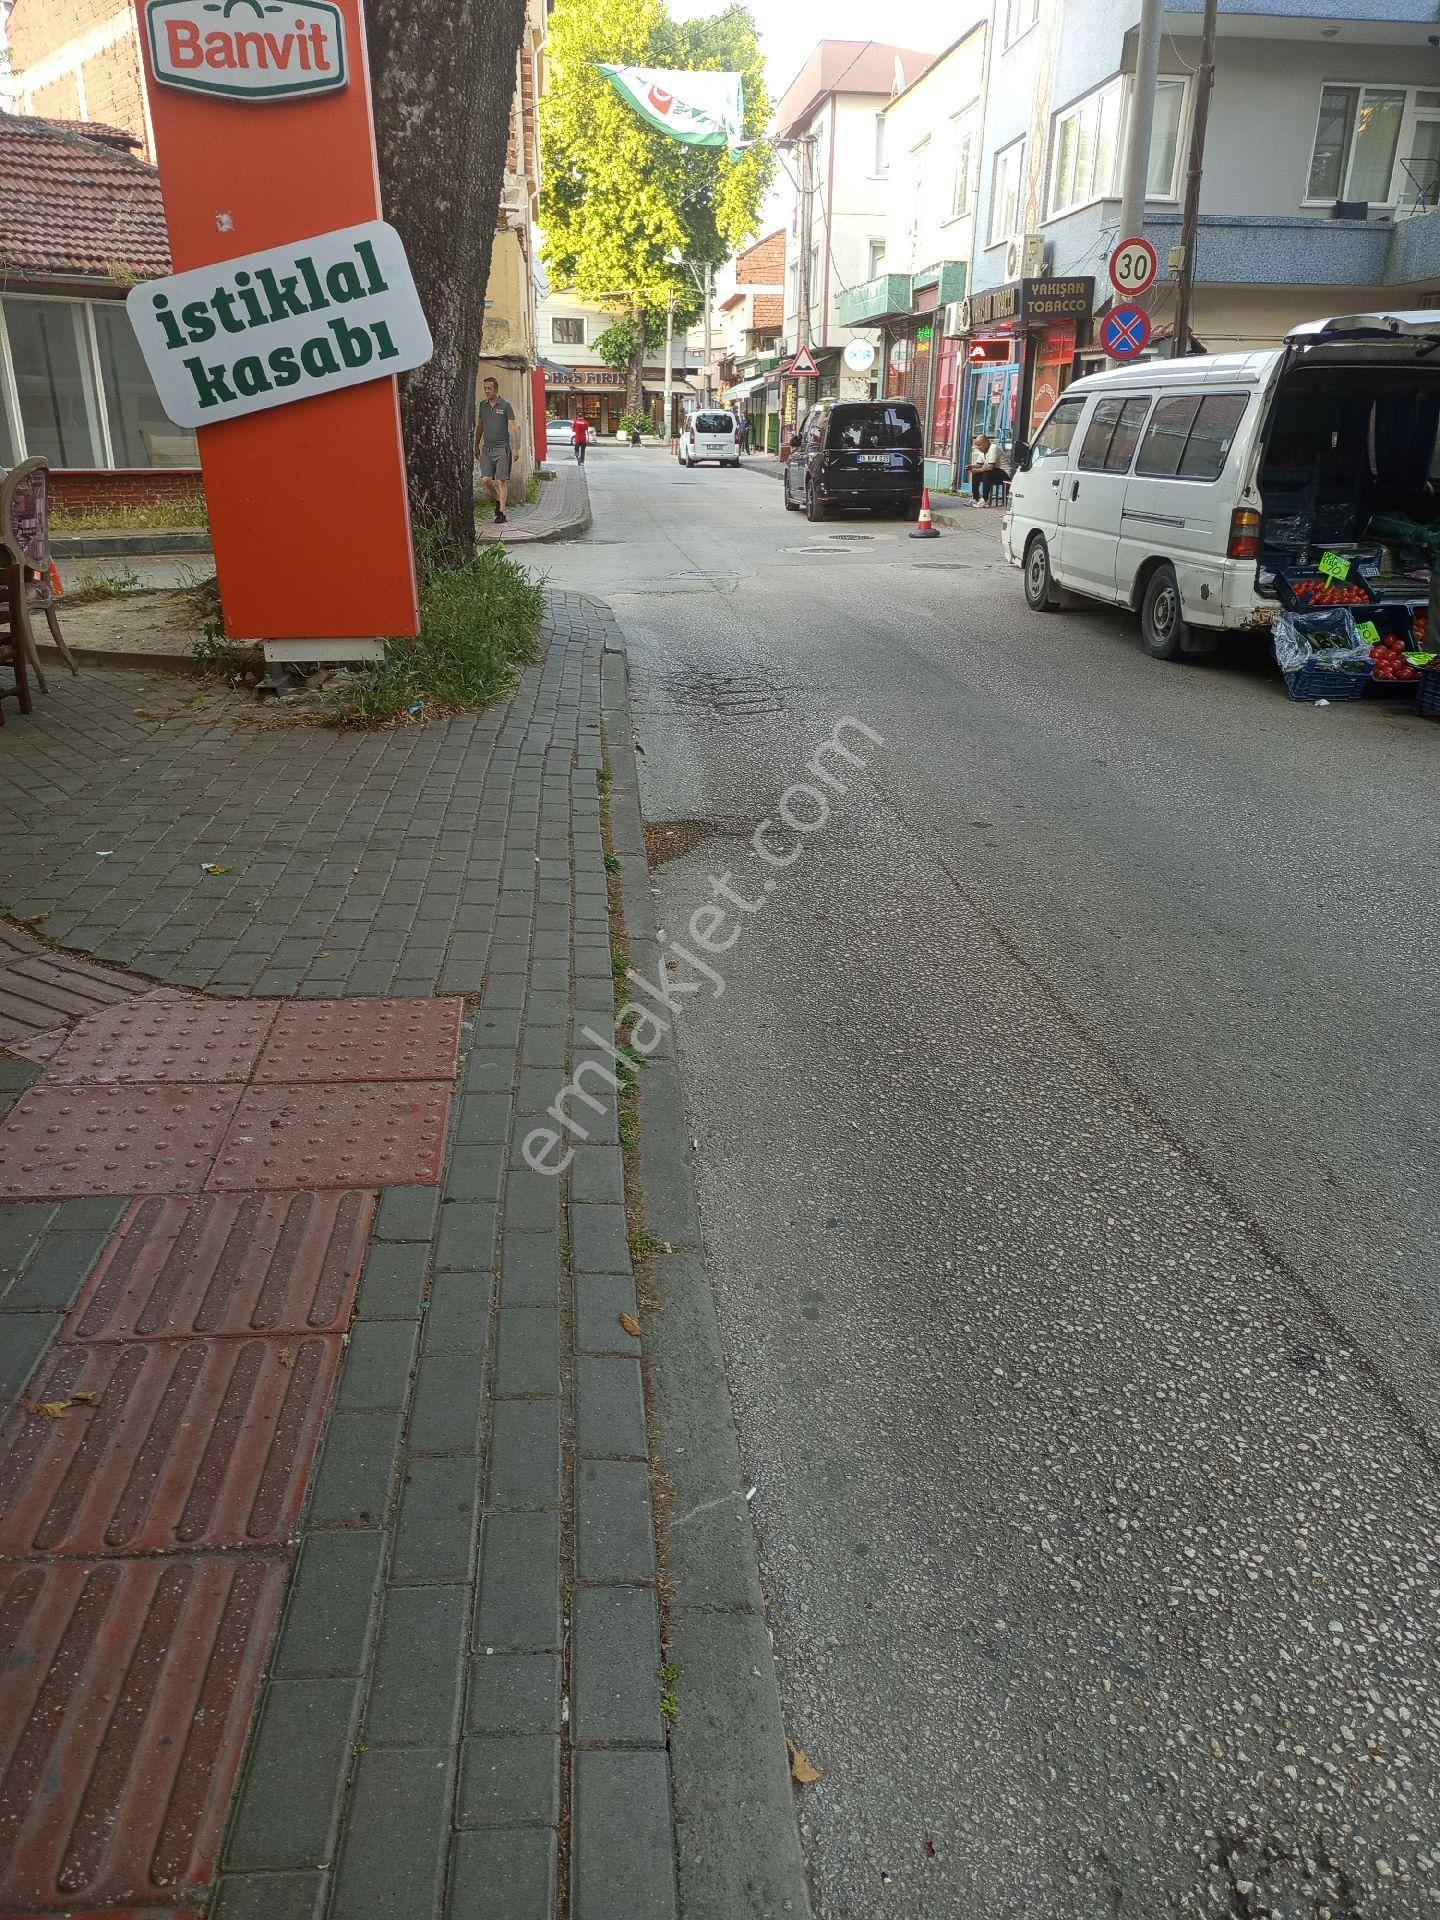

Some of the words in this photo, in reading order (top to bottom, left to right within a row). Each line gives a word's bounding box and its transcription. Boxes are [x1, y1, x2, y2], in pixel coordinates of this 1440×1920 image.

[165, 18, 331, 71] Banvit
[1119, 253, 1148, 281] 30
[152, 239, 389, 350] istiklal
[1027, 299, 1087, 313] TOBACCO
[1031, 282, 1085, 298] YAKIŞAN
[183, 315, 400, 408] kasabı
